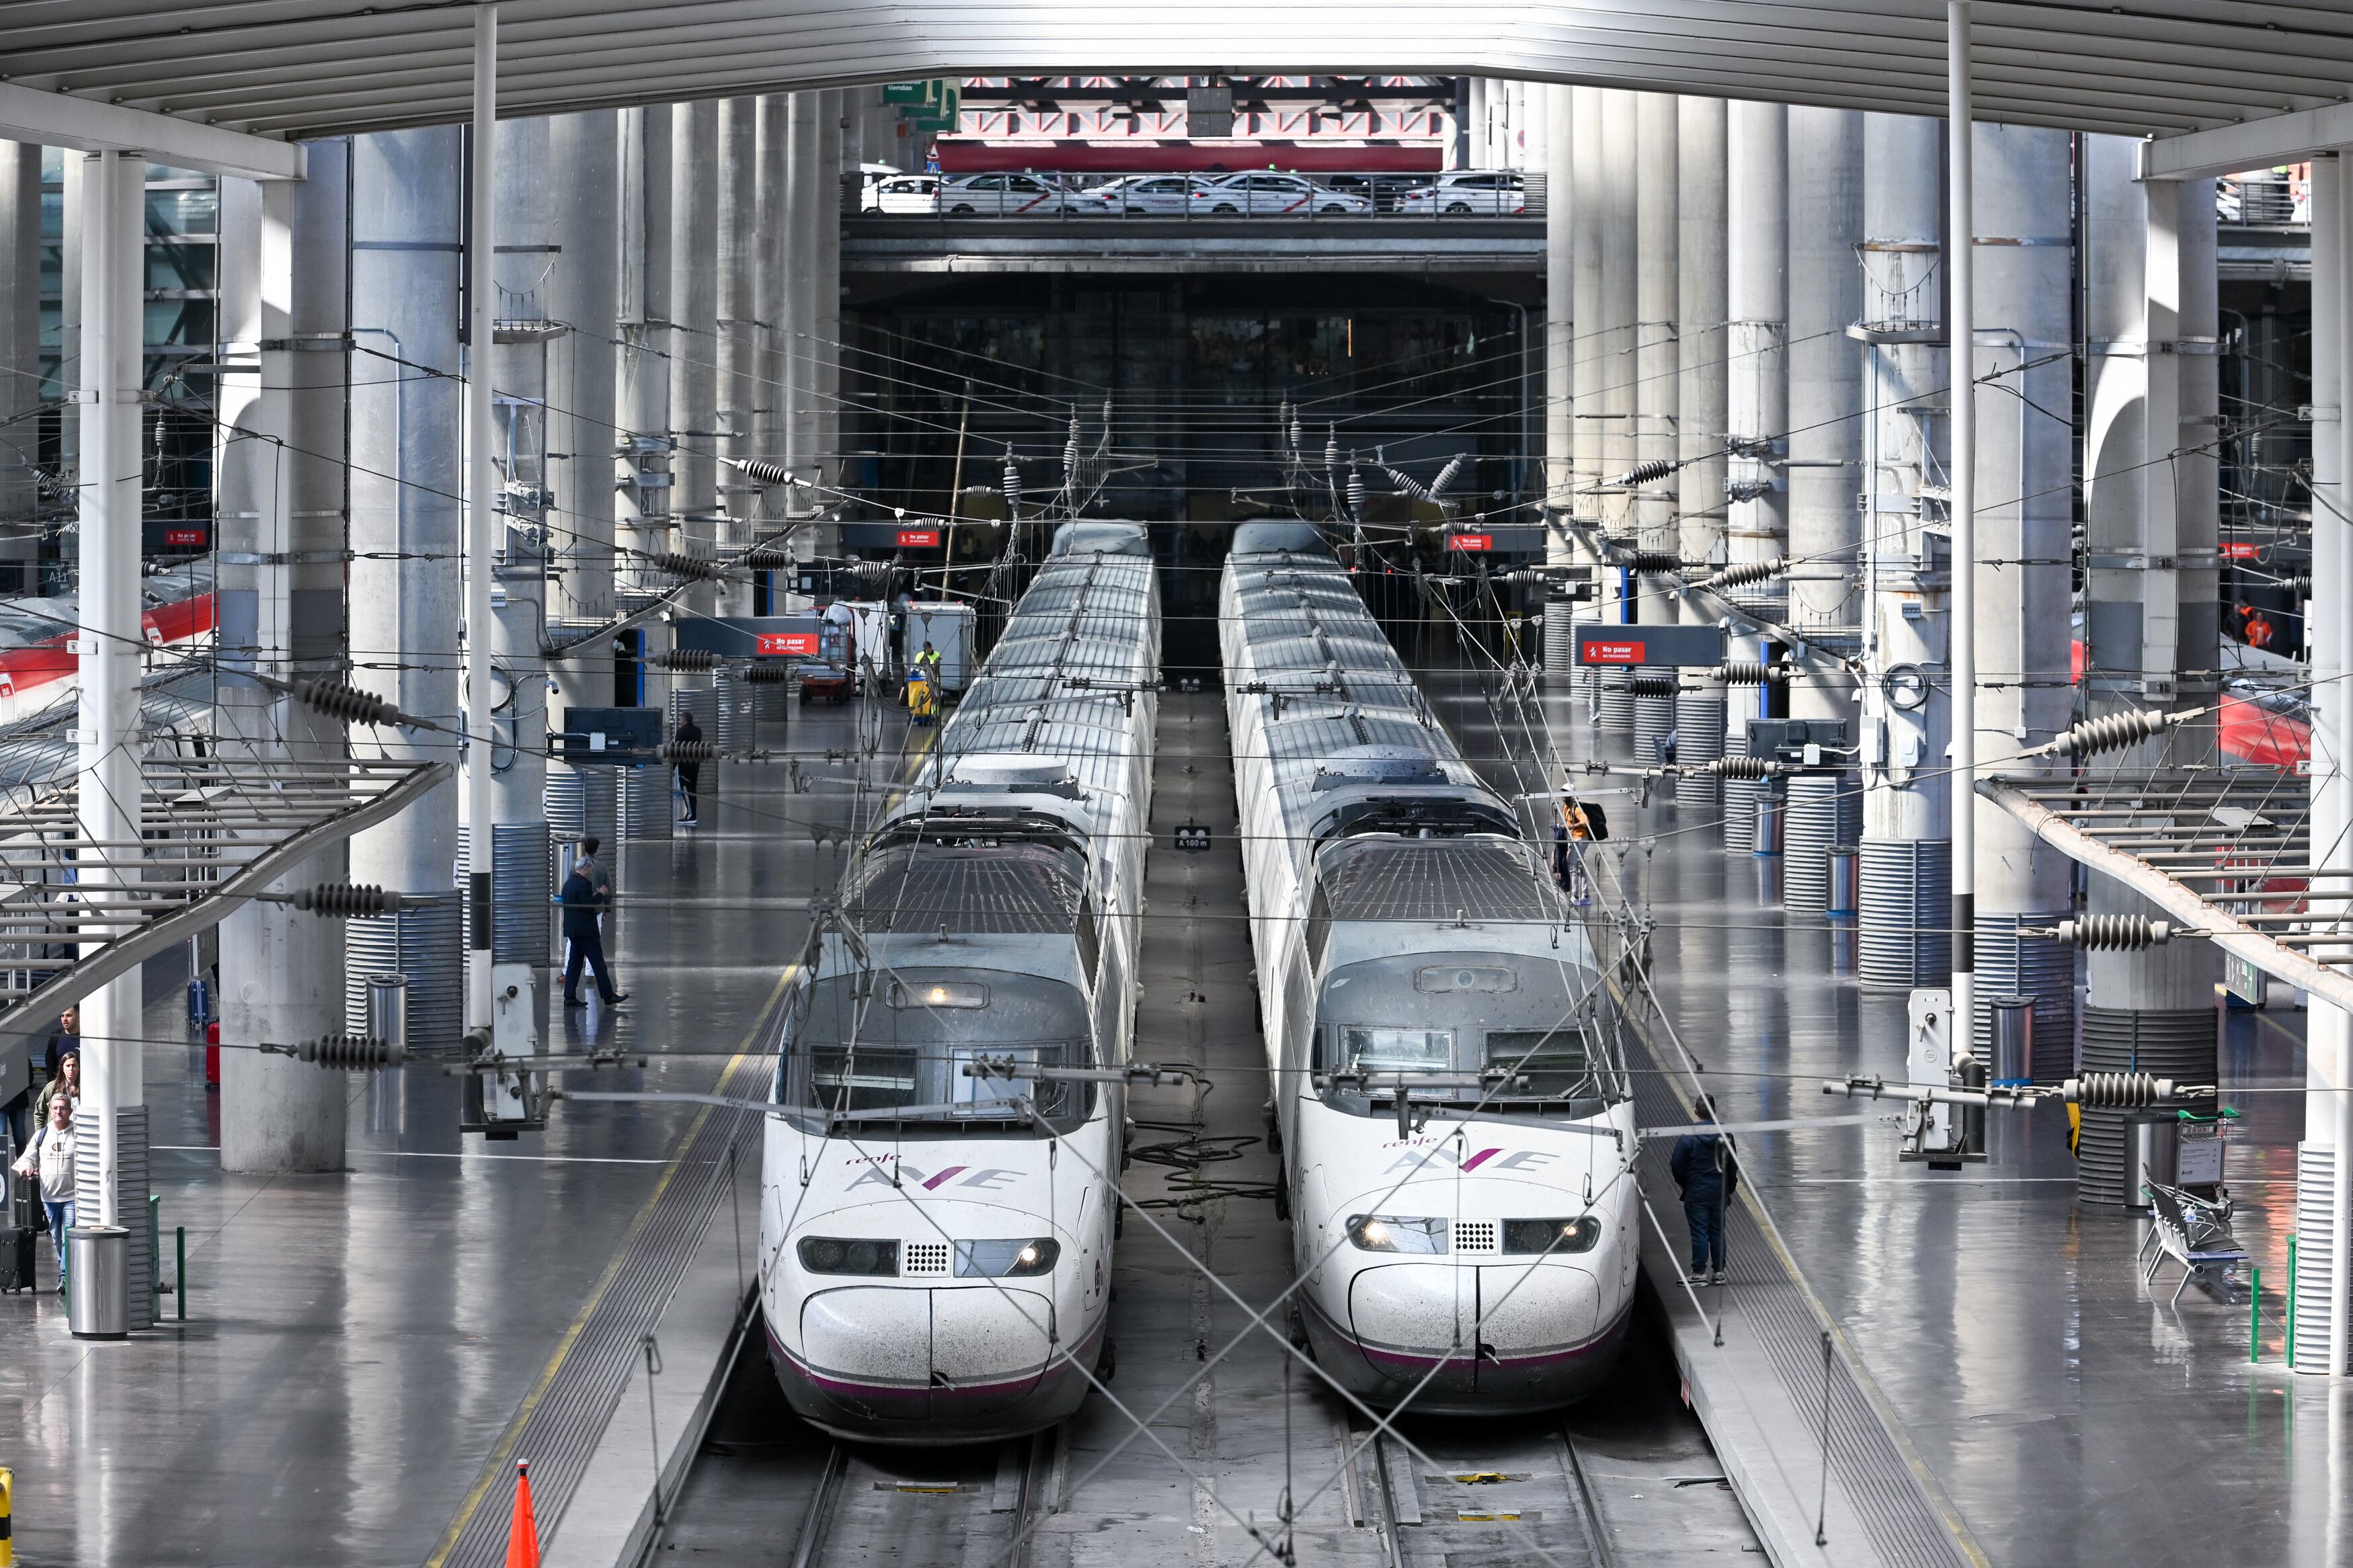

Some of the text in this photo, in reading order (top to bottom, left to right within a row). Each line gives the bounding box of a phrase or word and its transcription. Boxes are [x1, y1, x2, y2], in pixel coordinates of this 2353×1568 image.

[1382, 1136, 1437, 1149] renfe
[846, 1153, 902, 1165] renfe
[1382, 1148, 1561, 1175] AVE
[844, 1166, 1029, 1191] AVE
